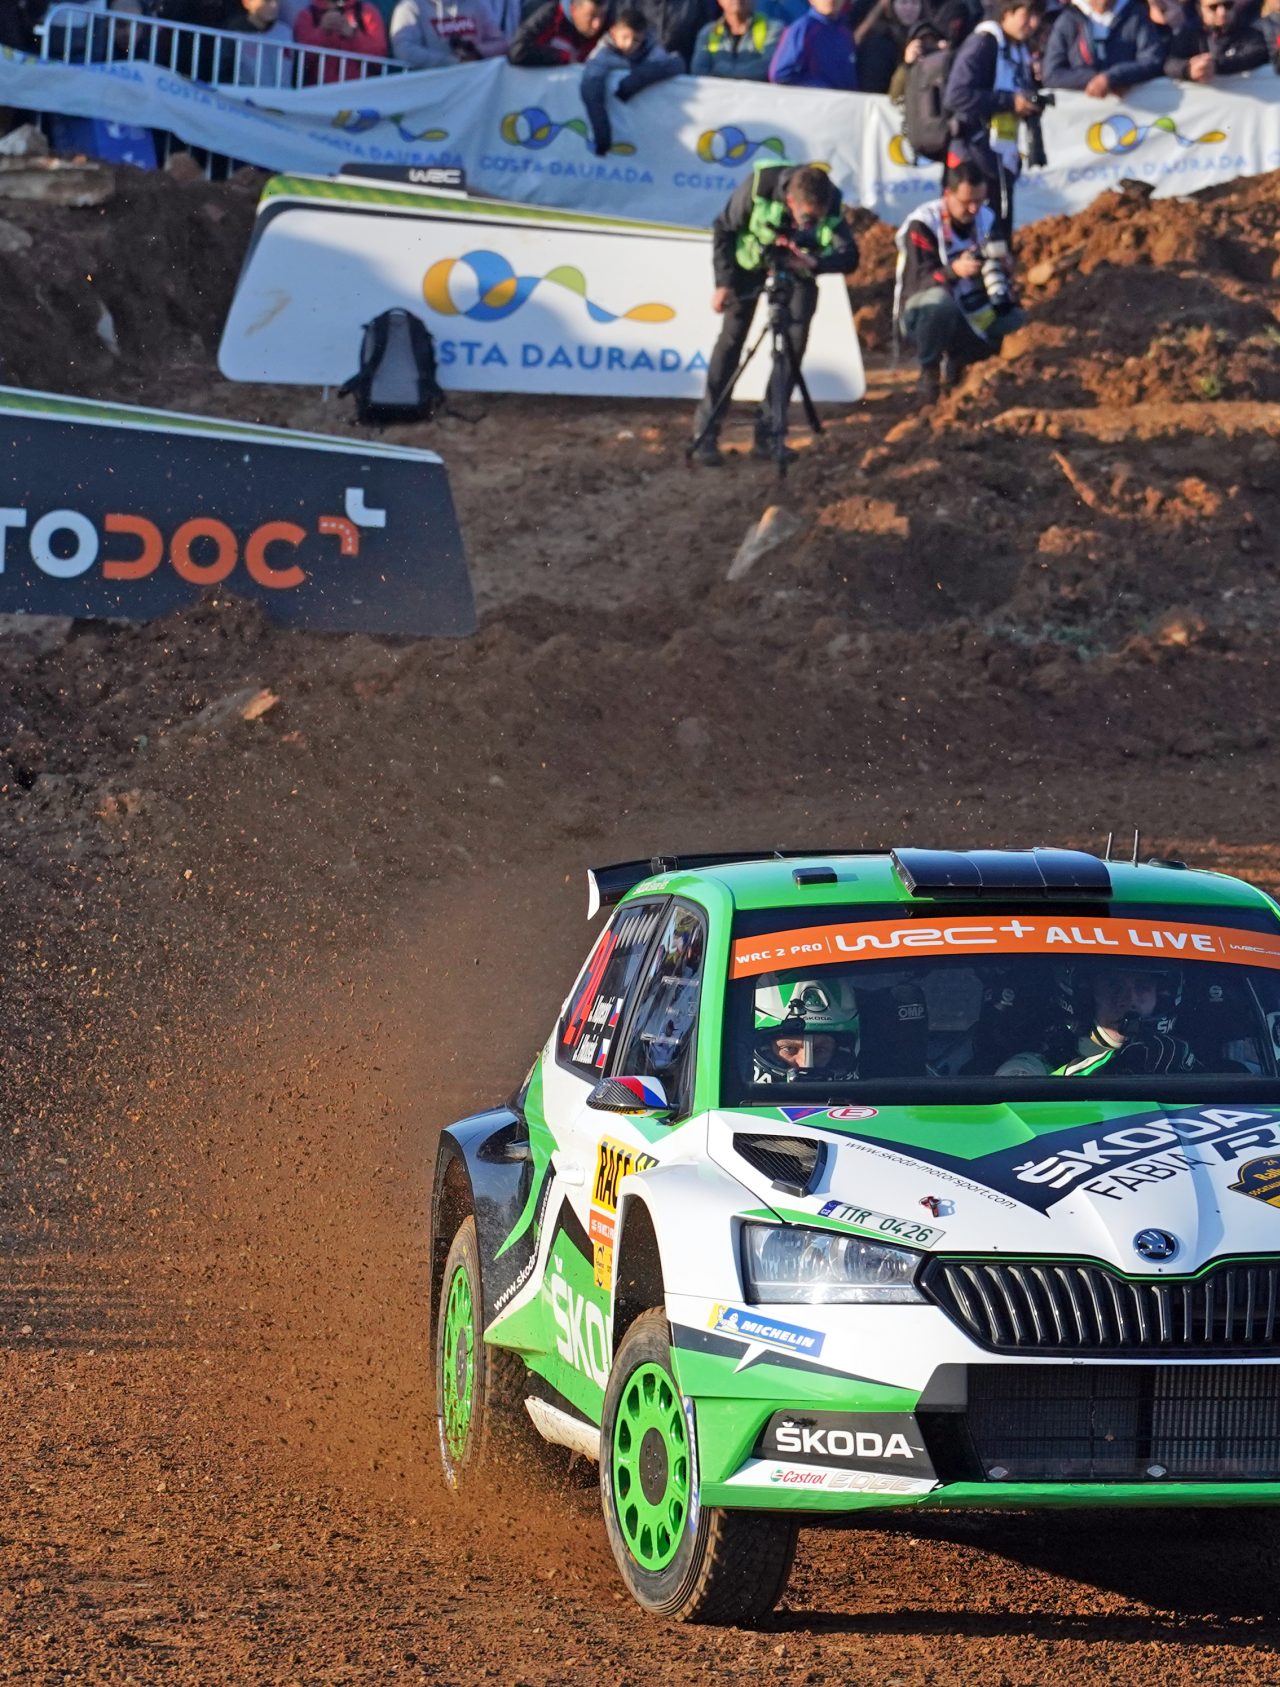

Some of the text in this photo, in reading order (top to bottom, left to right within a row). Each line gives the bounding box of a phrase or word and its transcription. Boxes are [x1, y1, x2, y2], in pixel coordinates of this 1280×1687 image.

[408, 168, 461, 184] WRC
[480, 155, 654, 184] COSTA DAURADA
[673, 171, 737, 191] COSTA
[440, 340, 709, 373] STA DAURADA
[735, 950, 772, 965] WRC
[775, 947, 787, 957] 2
[790, 942, 824, 955] PRO
[1045, 926, 1120, 946] ALL
[1127, 929, 1217, 953] LIVE
[1012, 1107, 1273, 1189] ŠKODA
[845, 1141, 1018, 1210] www.skoda-motorsport.com
[1084, 1150, 1217, 1201] FABIA
[879, 1218, 933, 1242] 0426
[551, 1254, 613, 1392] ŠKO
[740, 1320, 816, 1349] MICHELIN
[775, 1421, 914, 1459] ŠKODA
[782, 1469, 921, 1492] Castrol EDGE
